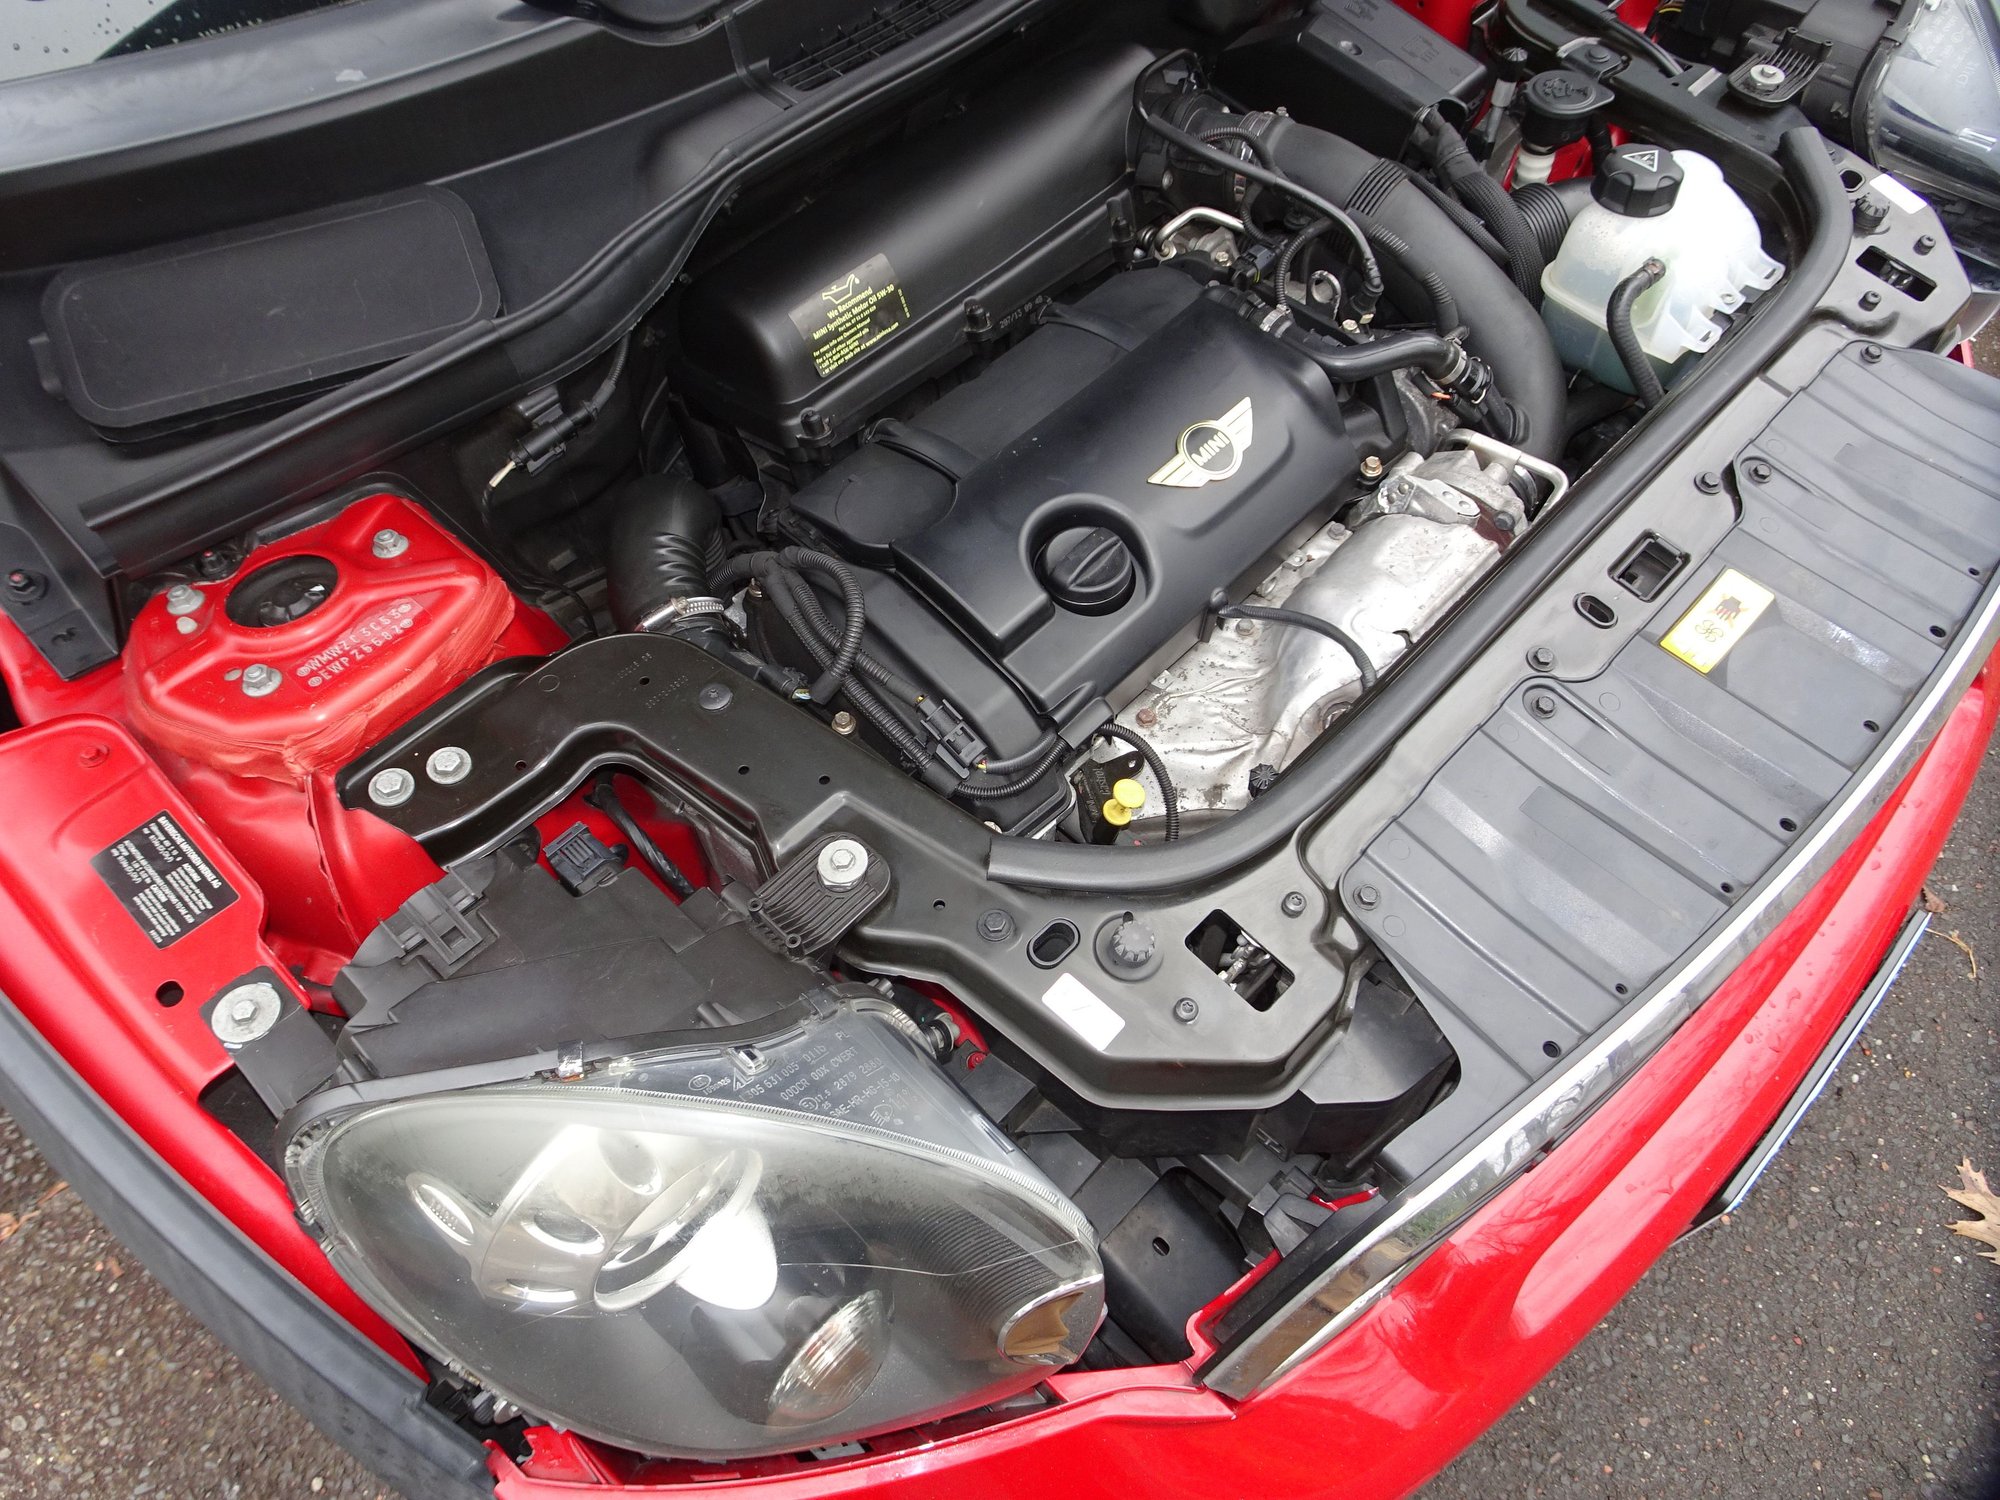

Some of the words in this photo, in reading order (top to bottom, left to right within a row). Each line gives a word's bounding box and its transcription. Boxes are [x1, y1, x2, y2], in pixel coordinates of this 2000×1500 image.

[813, 326, 827, 339] MINI
[827, 311, 852, 330] Synthetic
[851, 301, 868, 314] Motor
[868, 294, 877, 304] Oil
[876, 284, 894, 299] 5W-30
[827, 309, 838, 318] We
[837, 286, 872, 312] Recommend
[856, 317, 870, 328] Manual
[821, 359, 829, 368] call
[829, 362, 838, 370] visit
[844, 351, 853, 360] web
[1191, 432, 1231, 466] MINI
[158, 816, 184, 844] BAYERISCHE
[180, 842, 202, 865] MOTOREN
[198, 863, 215, 881] WERKE
[210, 879, 221, 888] AG
[764, 1073, 783, 1089] 631
[782, 1062, 800, 1078] 005
[834, 1071, 858, 1090] 2879
